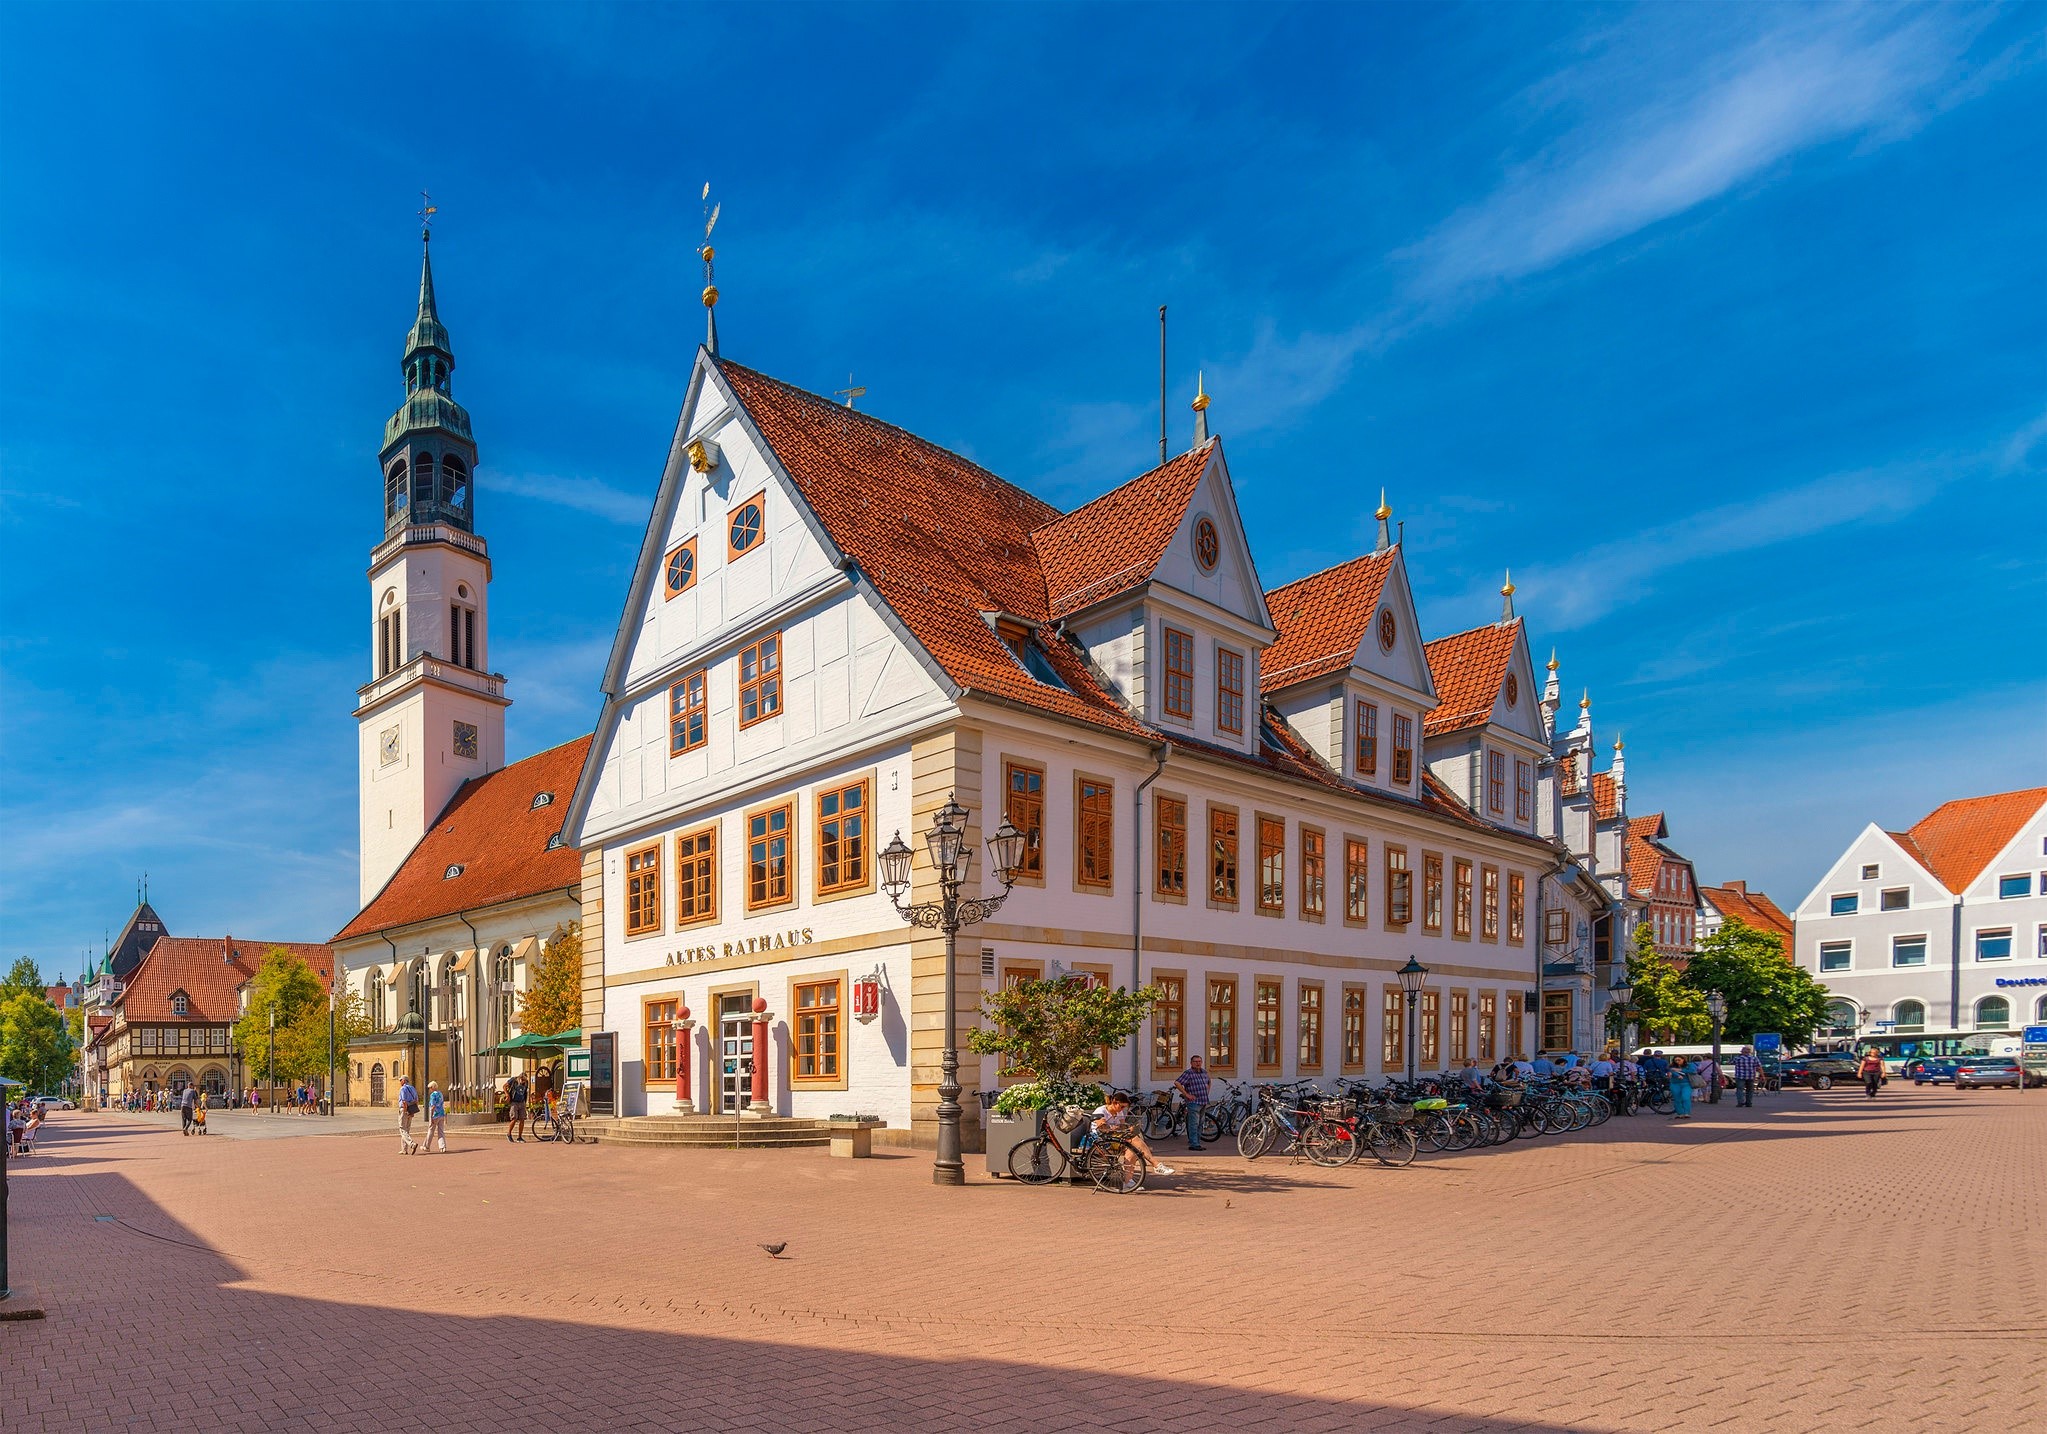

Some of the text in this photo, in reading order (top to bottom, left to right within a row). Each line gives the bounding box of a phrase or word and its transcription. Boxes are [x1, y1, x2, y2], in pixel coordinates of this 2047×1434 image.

[665, 927, 813, 967] ALTES RATHAUS
[1995, 977, 2047, 986] Deutsc
